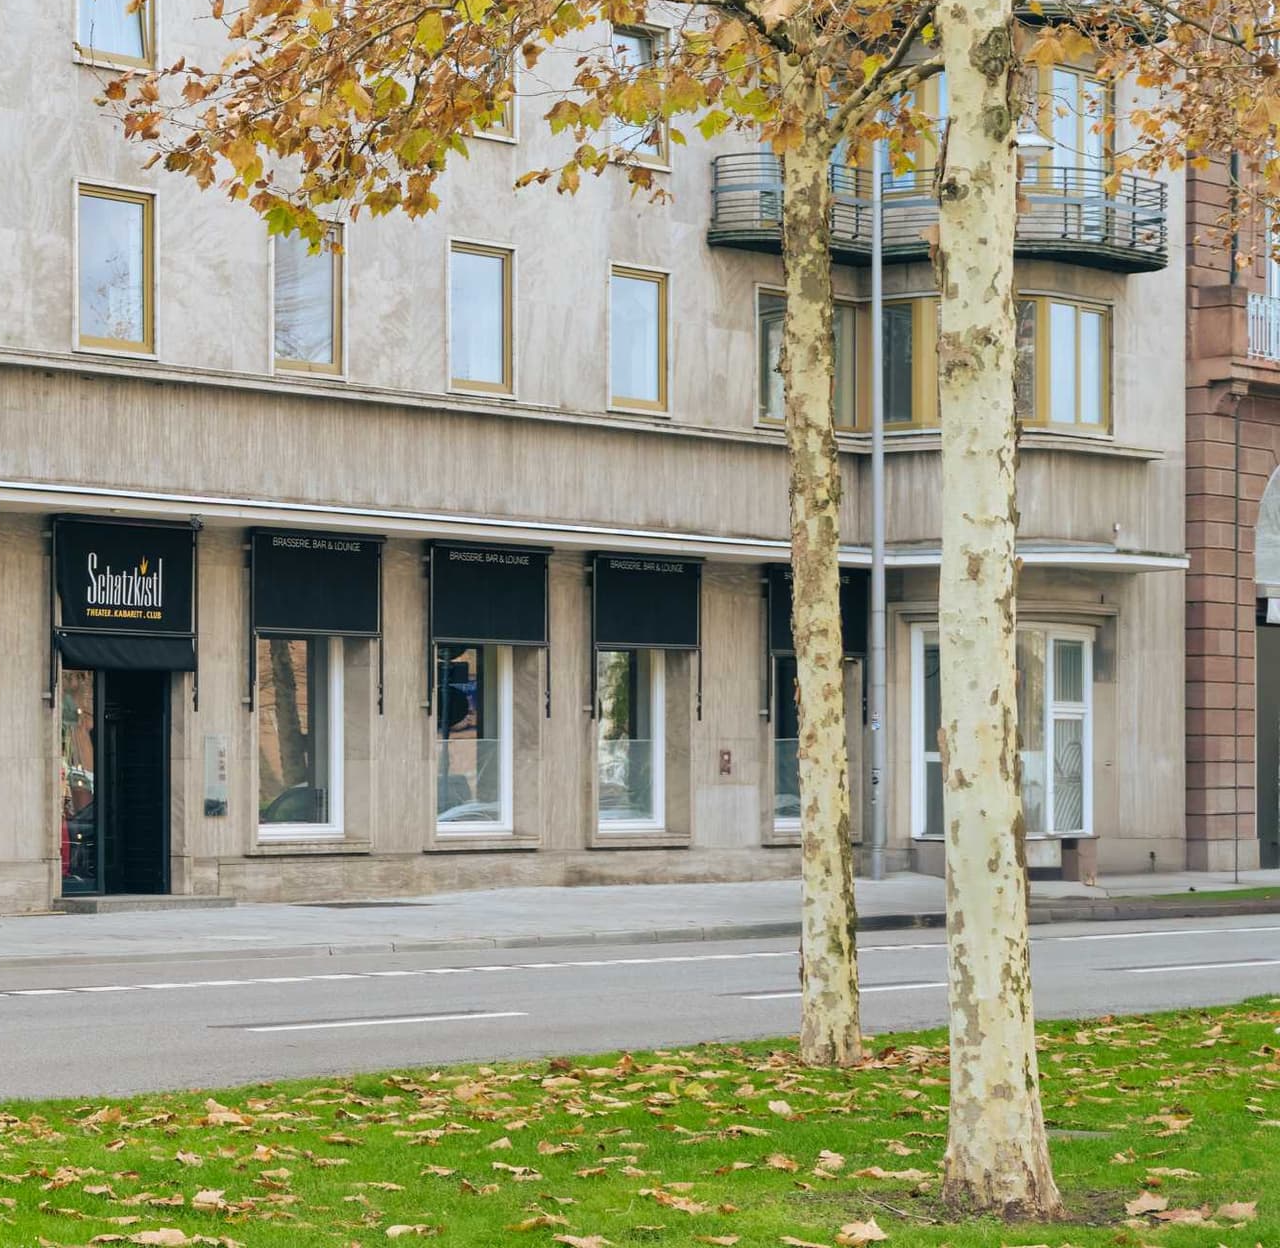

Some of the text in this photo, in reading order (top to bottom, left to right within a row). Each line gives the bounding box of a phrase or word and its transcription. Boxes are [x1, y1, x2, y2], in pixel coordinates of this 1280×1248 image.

[313, 539, 327, 550] BAR
[335, 541, 361, 552] LOUNGE
[485, 553, 499, 563] BAR
[87, 552, 162, 608] Schatzkistl
[146, 610, 162, 620] CLUB
